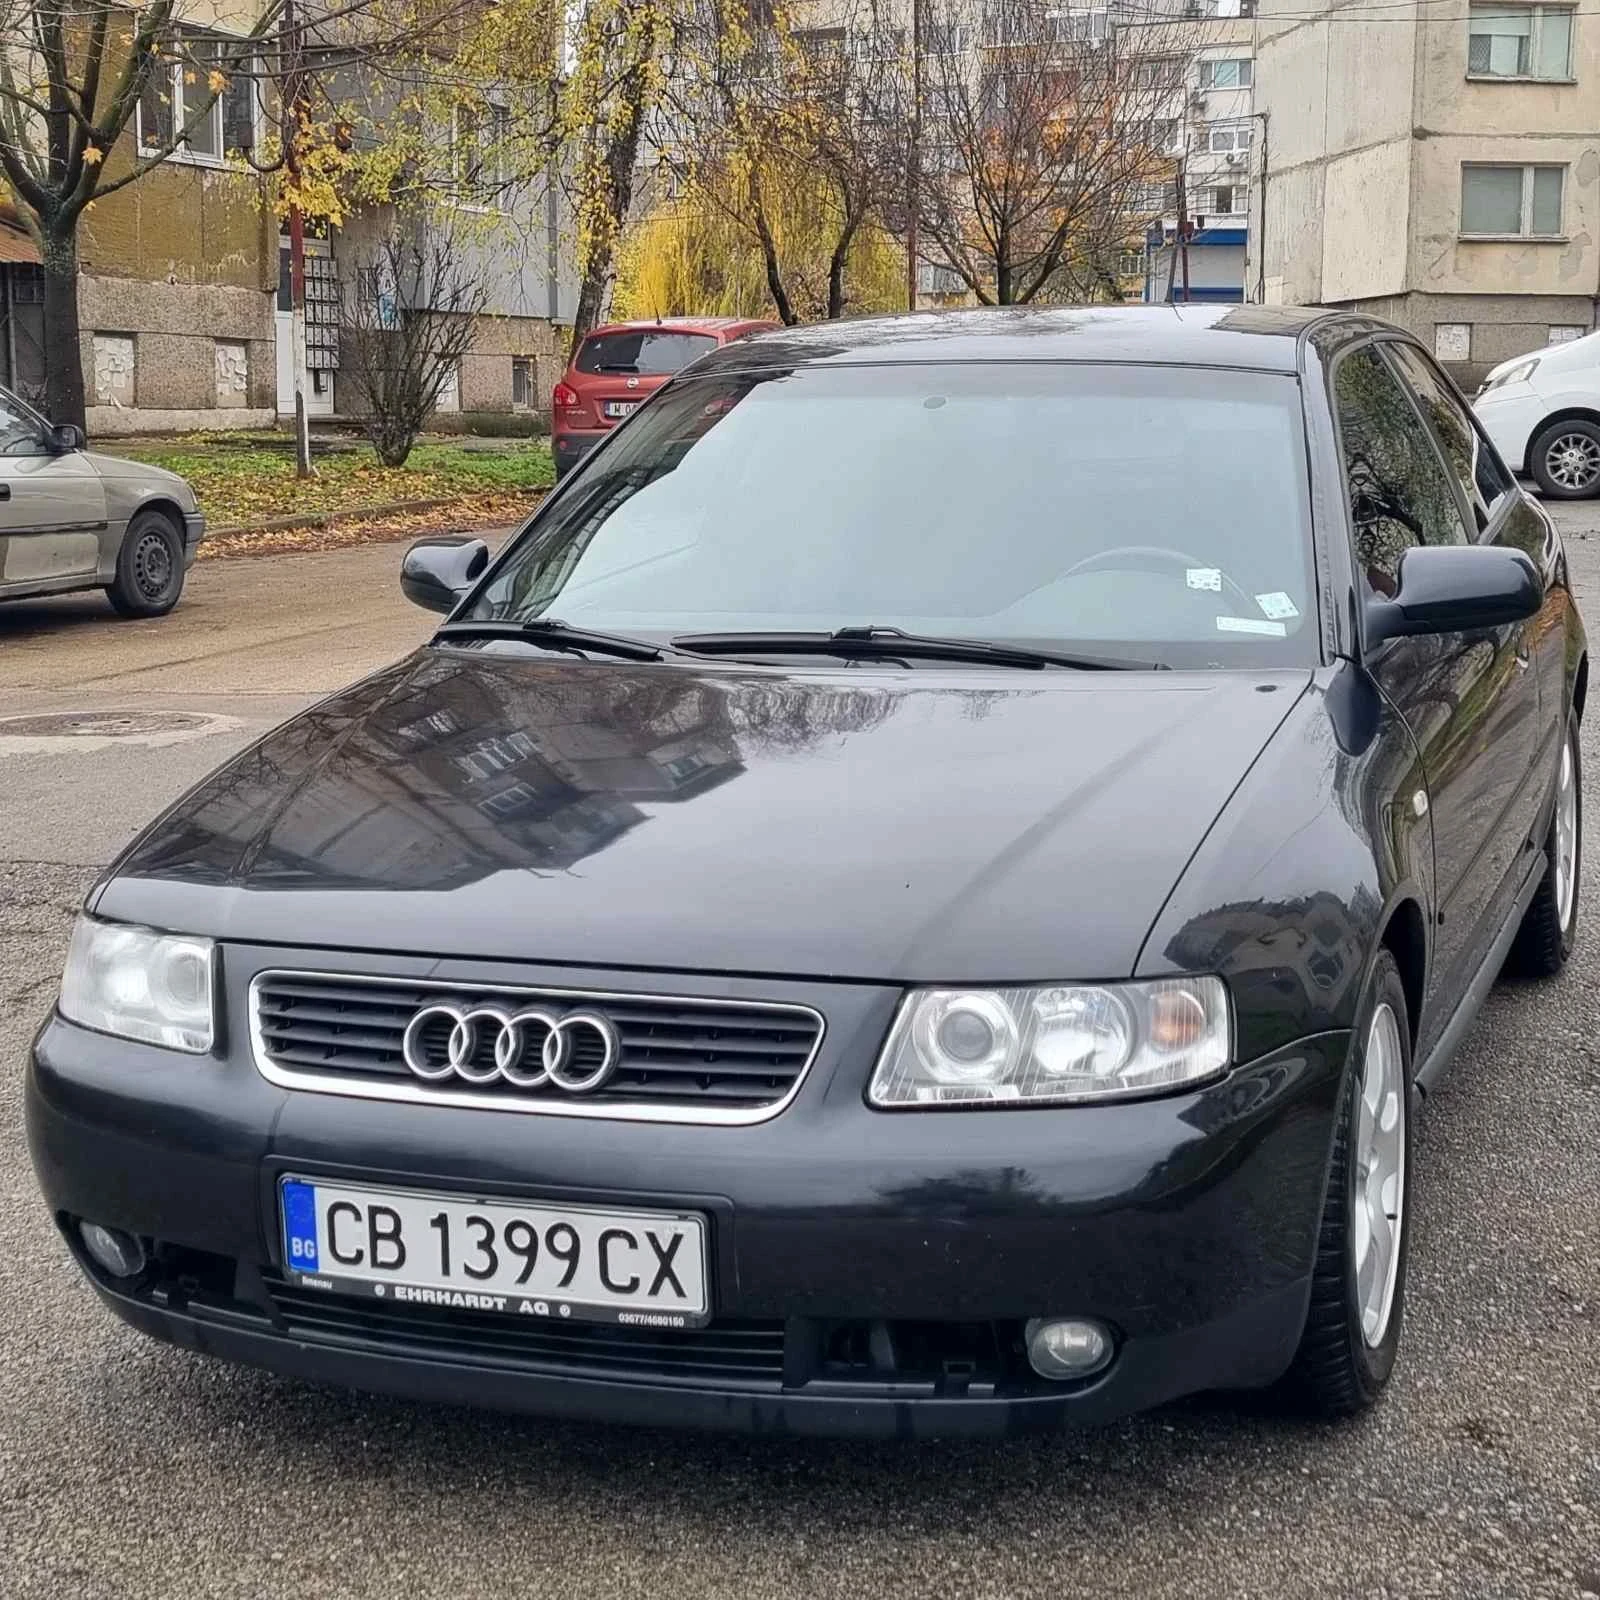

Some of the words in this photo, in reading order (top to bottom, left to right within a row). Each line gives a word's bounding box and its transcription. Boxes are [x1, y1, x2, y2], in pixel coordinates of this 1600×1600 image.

[292, 1237, 315, 1259] BG
[326, 1200, 406, 1271] CB
[430, 1212, 581, 1288] 1399
[598, 1228, 687, 1299] CX
[395, 1286, 507, 1311] EHRHARDT
[519, 1300, 550, 1316] AG
